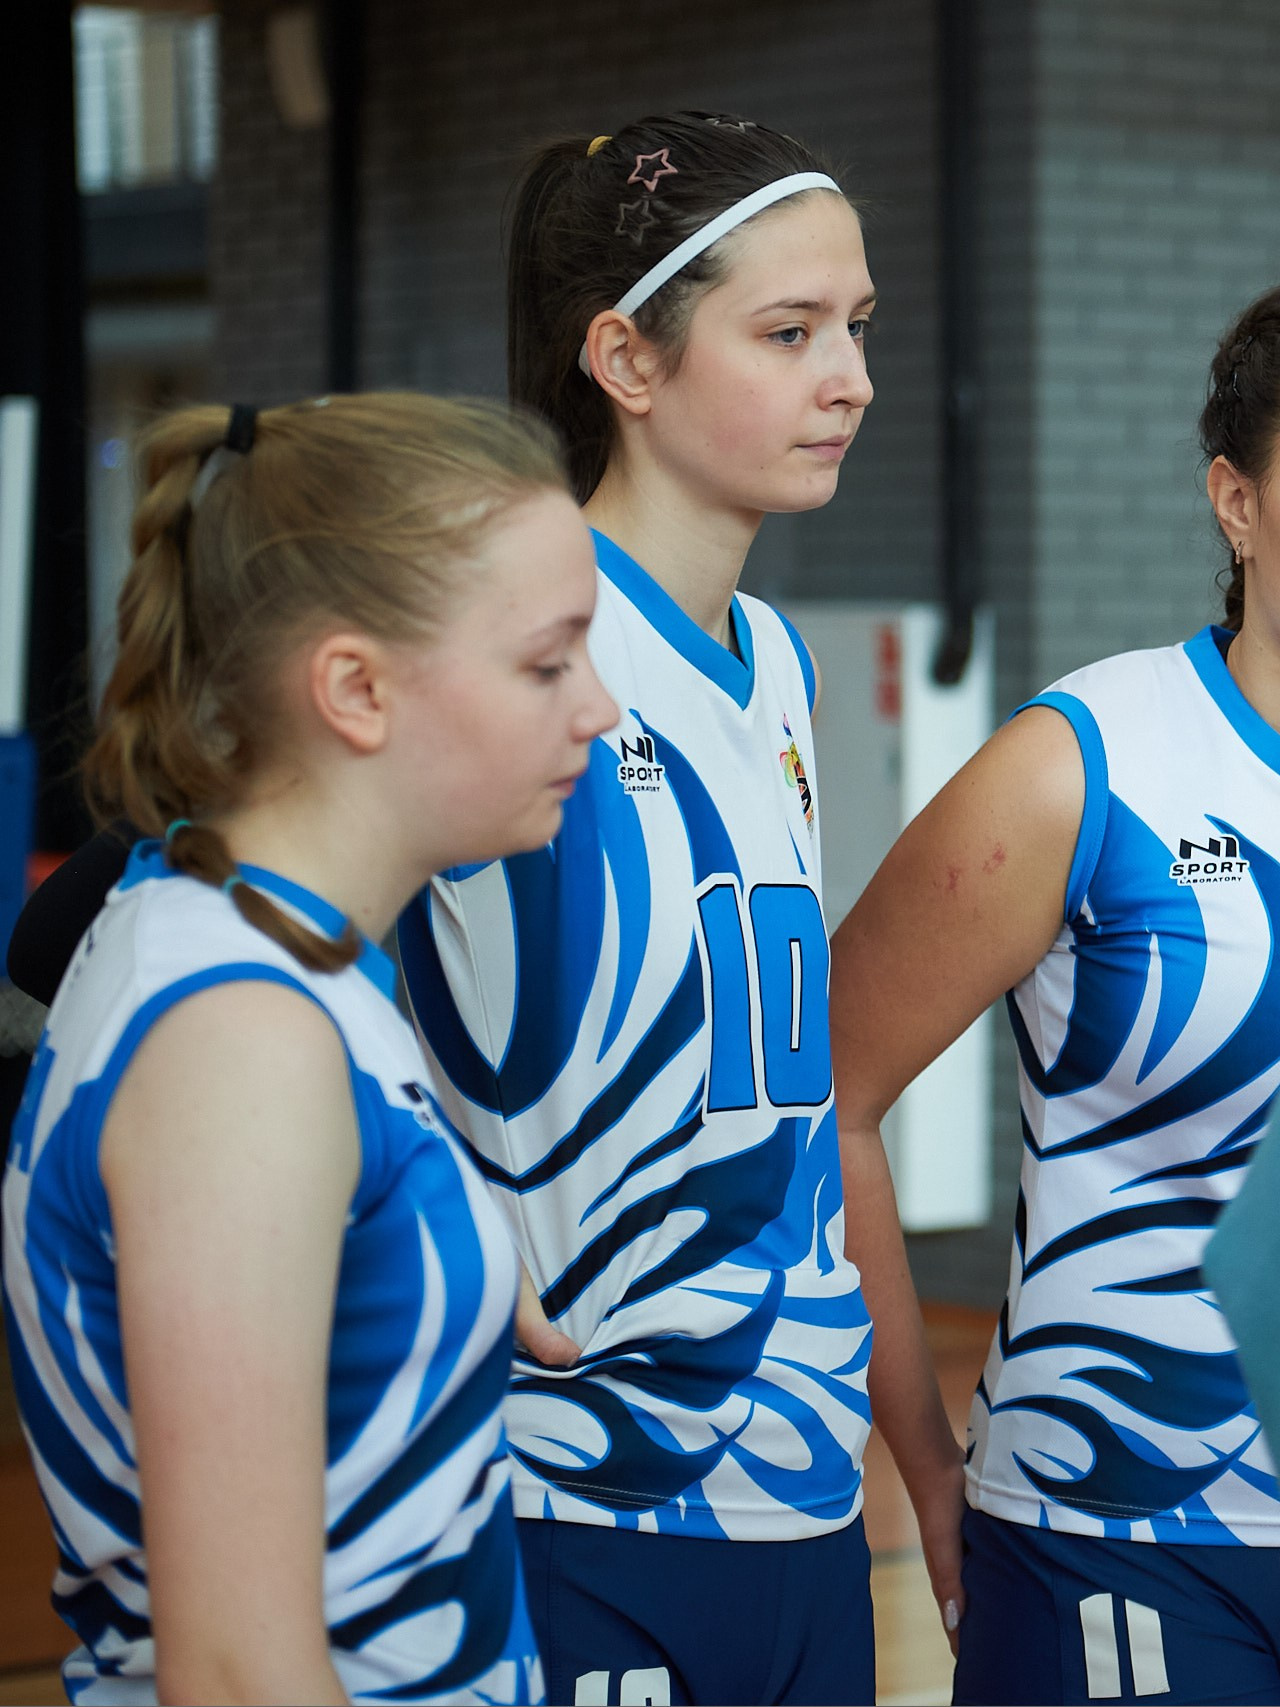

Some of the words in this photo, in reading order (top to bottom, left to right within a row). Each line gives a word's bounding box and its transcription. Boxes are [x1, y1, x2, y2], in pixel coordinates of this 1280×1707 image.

[620, 766, 663, 781] SPORT
[1172, 862, 1247, 876] SPORT
[1180, 876, 1242, 884] LABORATORY
[697, 883, 832, 1113] 10
[1079, 1593, 1171, 1698] 11
